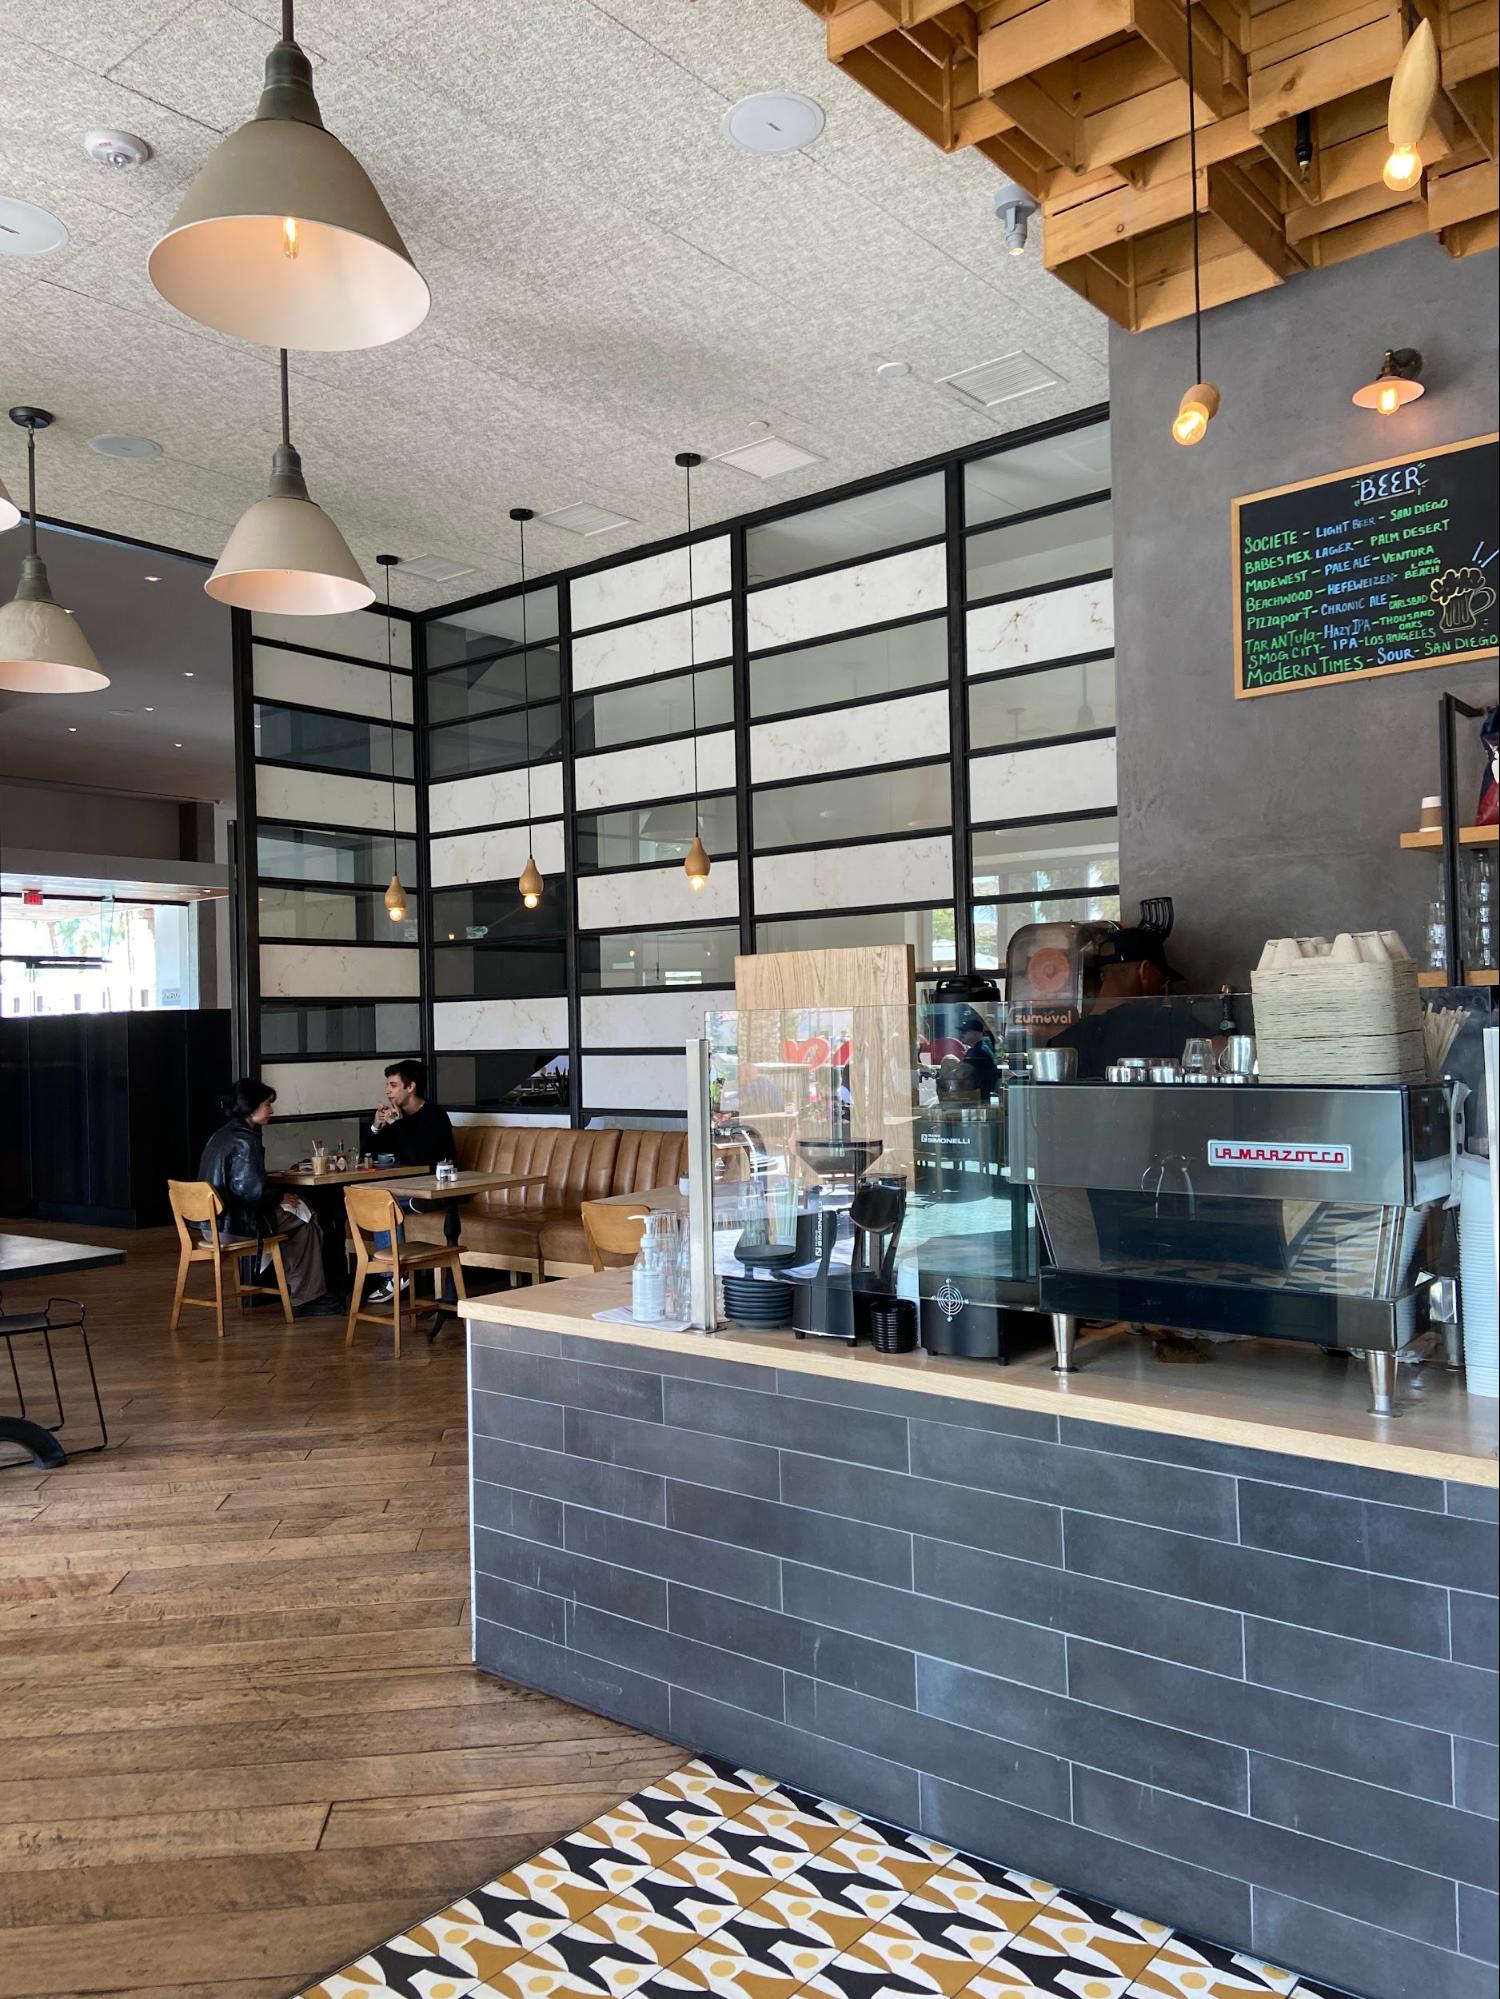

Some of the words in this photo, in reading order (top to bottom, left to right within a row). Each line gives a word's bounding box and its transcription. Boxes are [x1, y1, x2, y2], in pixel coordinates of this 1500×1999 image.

[1360, 466, 1421, 501] BEER
[1244, 530, 1298, 554] SOCIETE
[1316, 520, 1351, 538] LIGHT
[1352, 517, 1376, 530] BEER
[1390, 507, 1412, 522] SAN
[1414, 498, 1449, 515] DIEGO
[1244, 556, 1284, 575] BABES
[1286, 550, 1313, 565] MEX
[1315, 542, 1354, 559] LAGER
[1370, 532, 1400, 546] PALM
[1403, 519, 1450, 539] DESERT
[1410, 557, 1441, 570] LONG
[1246, 570, 1308, 594] MADEWEST
[1324, 560, 1352, 576] PALE
[1352, 555, 1372, 569] ALE
[1381, 545, 1435, 564] VENTURA
[1246, 589, 1313, 613] BEACHWOOD
[1328, 574, 1394, 595] HEFEWEIZEN
[1404, 565, 1440, 579] BEACH
[1320, 598, 1365, 616] CHRONIC
[1369, 594, 1388, 608] ALE
[1324, 624, 1351, 639] HAZY
[1352, 618, 1371, 636] IPA
[1379, 609, 1435, 626] THOUSAND
[1248, 650, 1289, 670] SMOG
[1292, 643, 1320, 658] CITY
[1333, 638, 1358, 650] IPA
[1364, 635, 1384, 646] LOS
[1386, 628, 1437, 643] ANGELES
[1319, 656, 1364, 674] TIMES
[1377, 647, 1416, 665] SOUR
[1425, 642, 1451, 656] SAN
[1455, 634, 1498, 650] DIEGO
[1015, 1010, 1072, 1024] zumoval
